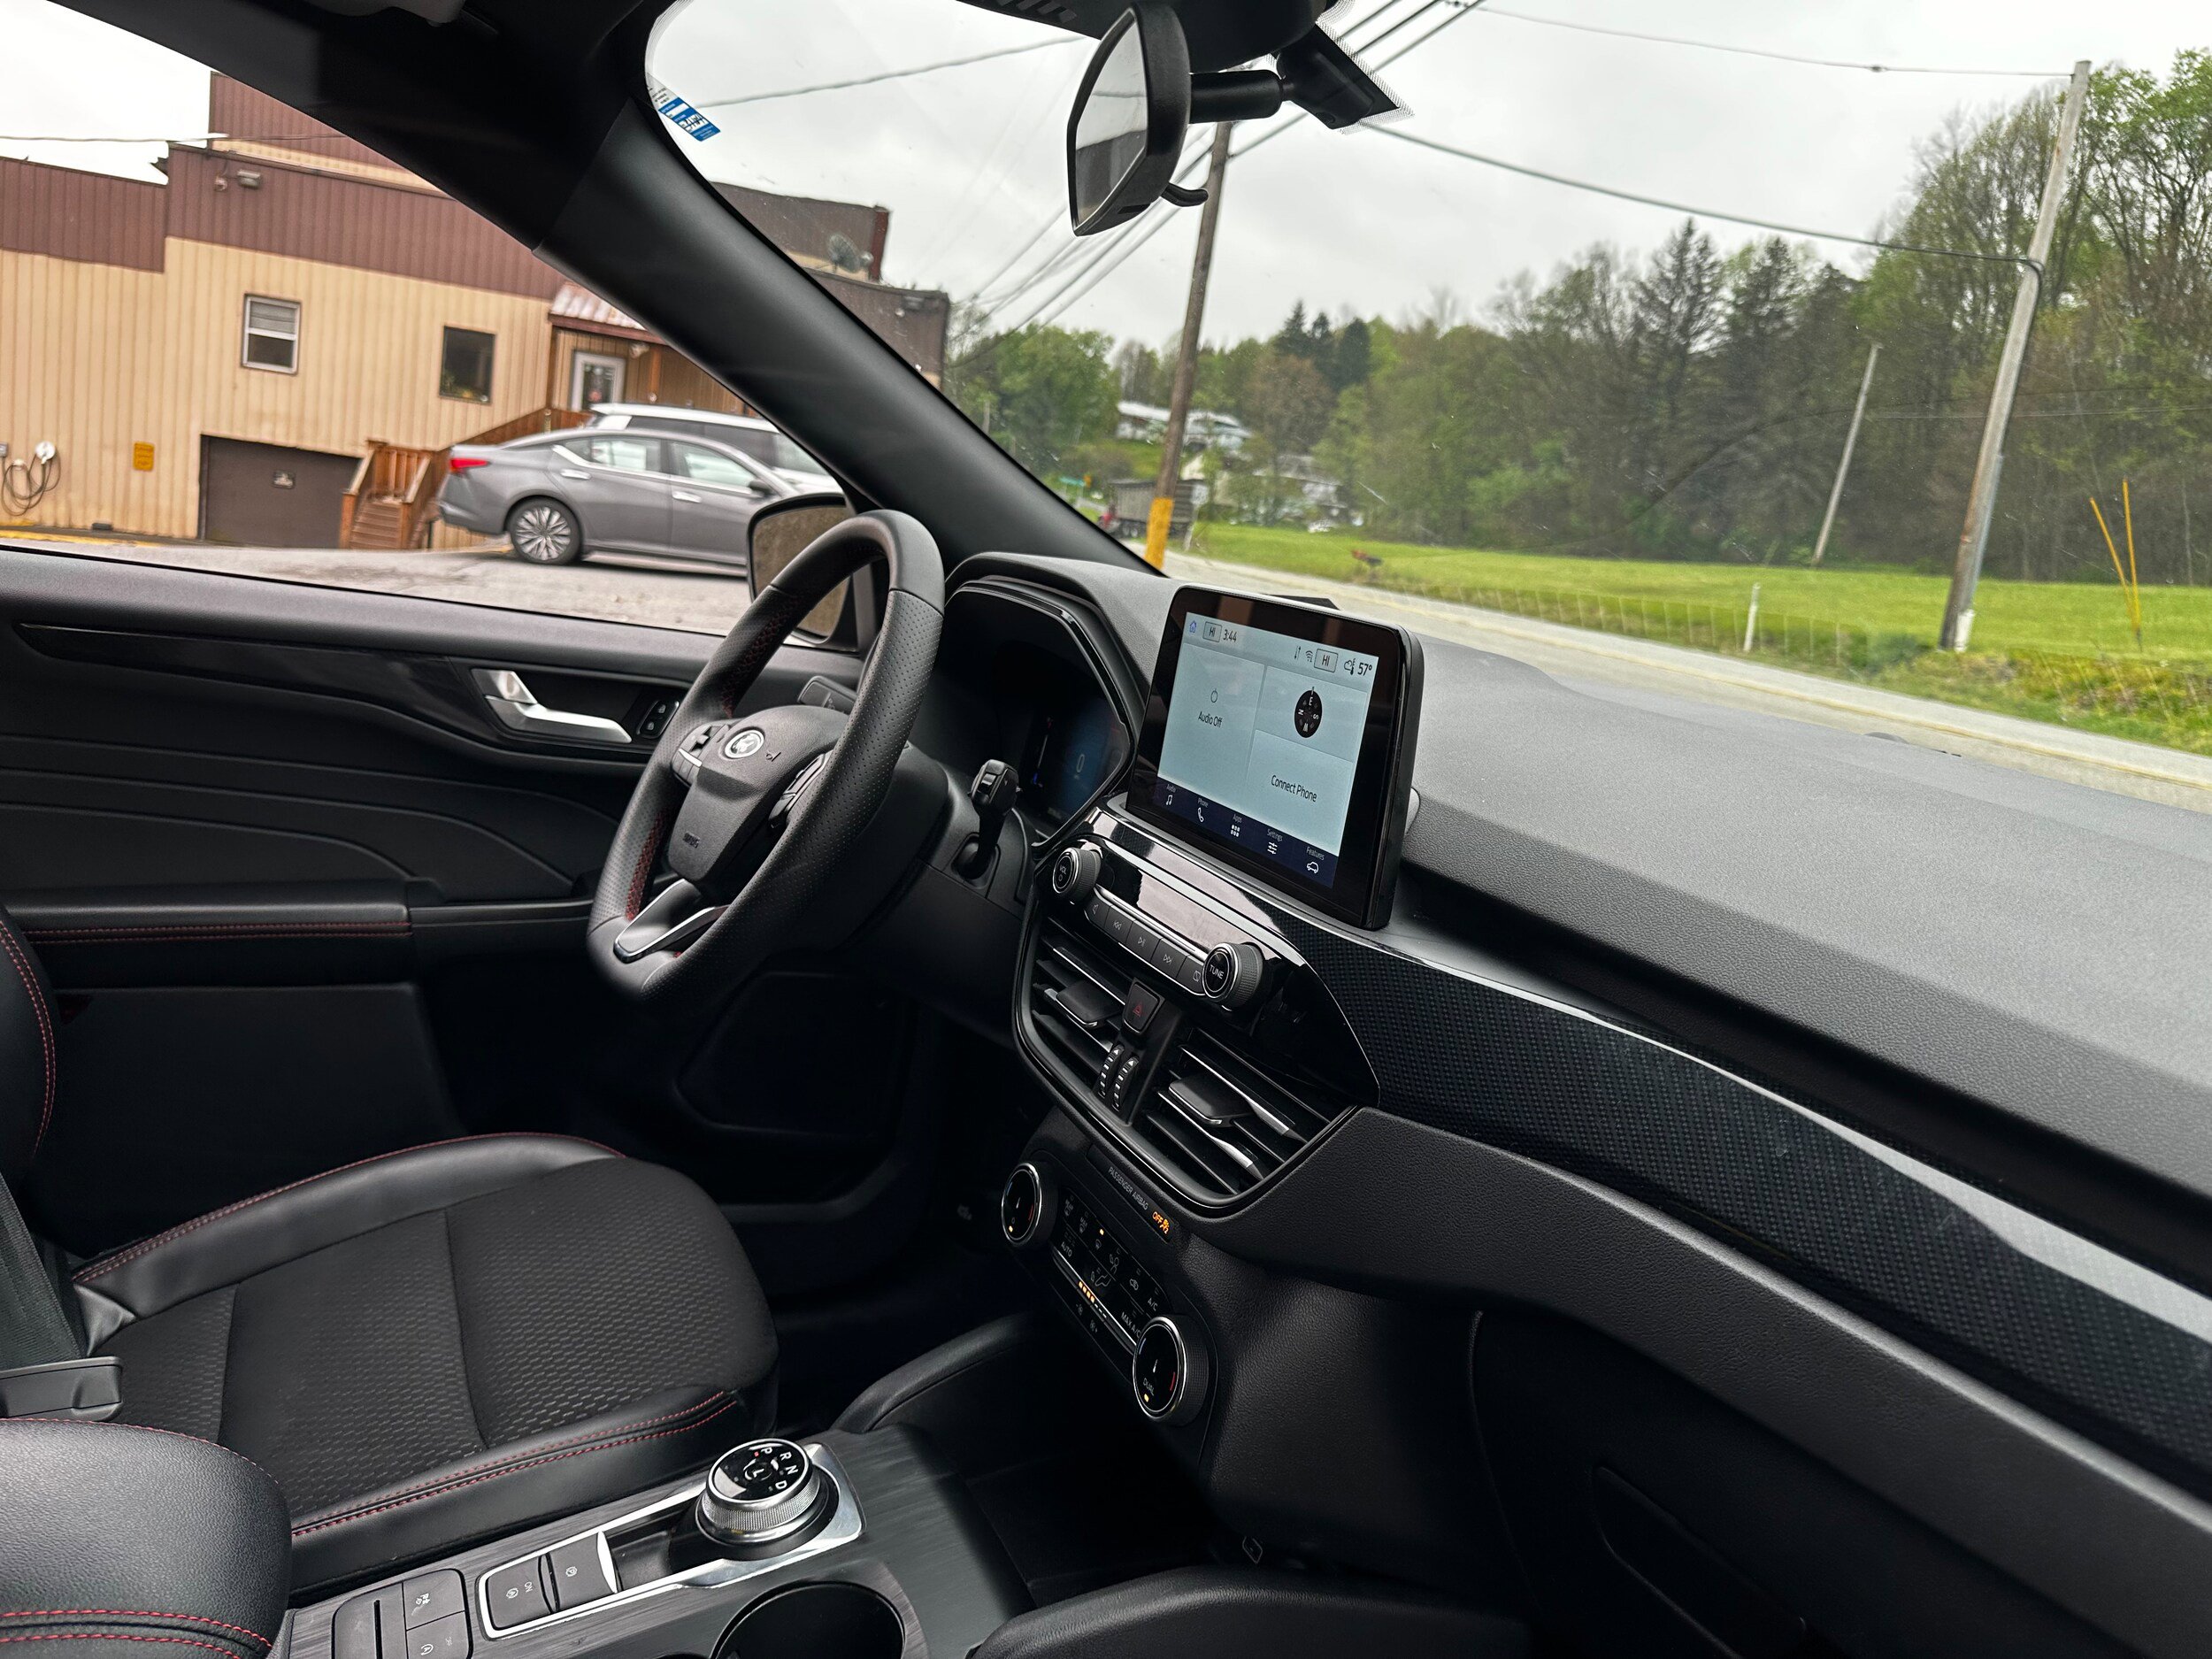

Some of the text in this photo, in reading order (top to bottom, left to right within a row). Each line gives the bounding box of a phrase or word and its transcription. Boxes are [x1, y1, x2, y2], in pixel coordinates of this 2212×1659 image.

[1223, 629, 1238, 642] 3:44
[1198, 711, 1213, 725] Audio
[1271, 774, 1317, 803] Connect Phone
[1198, 798, 1209, 809] Phone
[1233, 813, 1243, 824] Apps
[1267, 829, 1284, 842] Settings
[1307, 846, 1325, 862] Features
[1209, 964, 1225, 979] TUNE
[1108, 1166, 1164, 1224] PASSENGER AIRBAG OFF
[1061, 1240, 1073, 1257] AUTO
[1147, 1297, 1158, 1311] A/C
[1120, 1311, 1142, 1339] MAX A/C
[1142, 1378, 1155, 1396] DUAL
[780, 1451, 792, 1462] R
[785, 1464, 798, 1475] N
[775, 1480, 787, 1489] D
